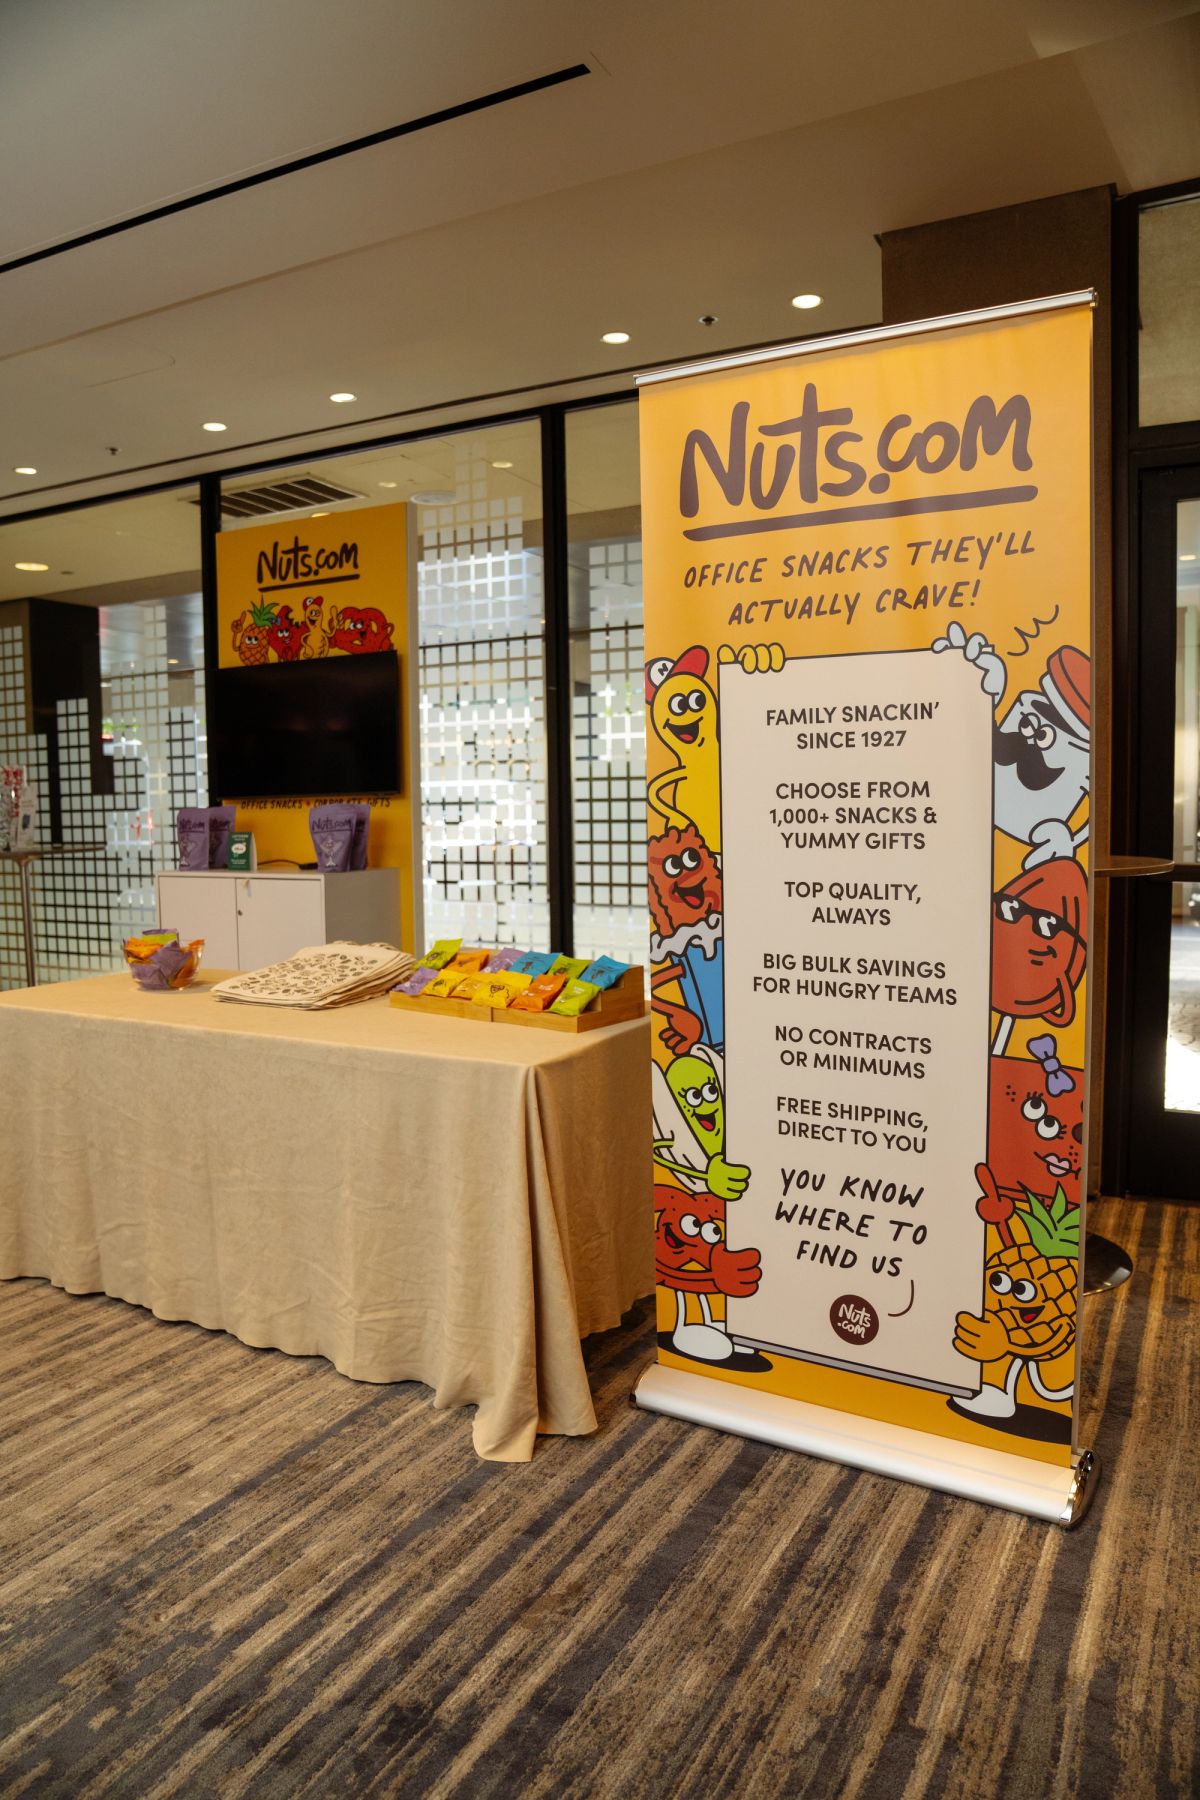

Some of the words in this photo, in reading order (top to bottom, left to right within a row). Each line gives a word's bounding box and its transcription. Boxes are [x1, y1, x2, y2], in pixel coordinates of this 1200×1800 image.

[680, 384, 1033, 518] Nuts.com
[257, 535, 359, 584] Nuts.com
[684, 558, 767, 588] OFFICE
[782, 546, 889, 577] SNACKS
[907, 531, 1035, 570] THEY'LL
[728, 593, 861, 625] ACTUALLY
[876, 580, 980, 612] CRAVE!
[766, 707, 837, 726] FAMILY
[797, 732, 856, 749] SINCE
[862, 730, 907, 748] 1927
[776, 782, 860, 799] CHOOSE
[868, 781, 930, 798] FROM
[241, 800, 267, 810] OFFICE
[270, 799, 303, 809] SNACKS
[770, 809, 830, 828] 1,000+
[836, 807, 916, 824] SNACKS
[924, 807, 937, 824] &
[781, 833, 860, 849] YUMMY
[865, 833, 925, 849] GIFTS
[784, 882, 823, 898] TOP
[829, 882, 920, 904] QUALITY,
[812, 907, 890, 925] ALWAYS
[764, 953, 796, 970] BIG
[803, 955, 851, 973] BULK
[857, 958, 945, 979] SAVINGS
[754, 977, 790, 994] FOR
[797, 979, 880, 1000] HUNGRY
[885, 985, 957, 1005] TEAMS
[776, 1026, 803, 1042] NO
[809, 1029, 931, 1054] CONTRACTS
[780, 1050, 807, 1067] OR
[814, 1053, 925, 1079] MINIMUMS
[777, 1096, 821, 1116] FREE
[828, 1103, 928, 1132] SHIPPING,
[779, 1120, 846, 1143] DIRECT
[851, 1129, 877, 1147] TO
[883, 1133, 926, 1153] YOU
[781, 1168, 826, 1196] YOU
[840, 1176, 924, 1208] KNOW
[775, 1201, 874, 1237] WHERE
[889, 1220, 927, 1245] TO
[797, 1240, 857, 1268] FIND
[872, 1256, 902, 1277] US
[838, 1303, 871, 1327] Nuts
